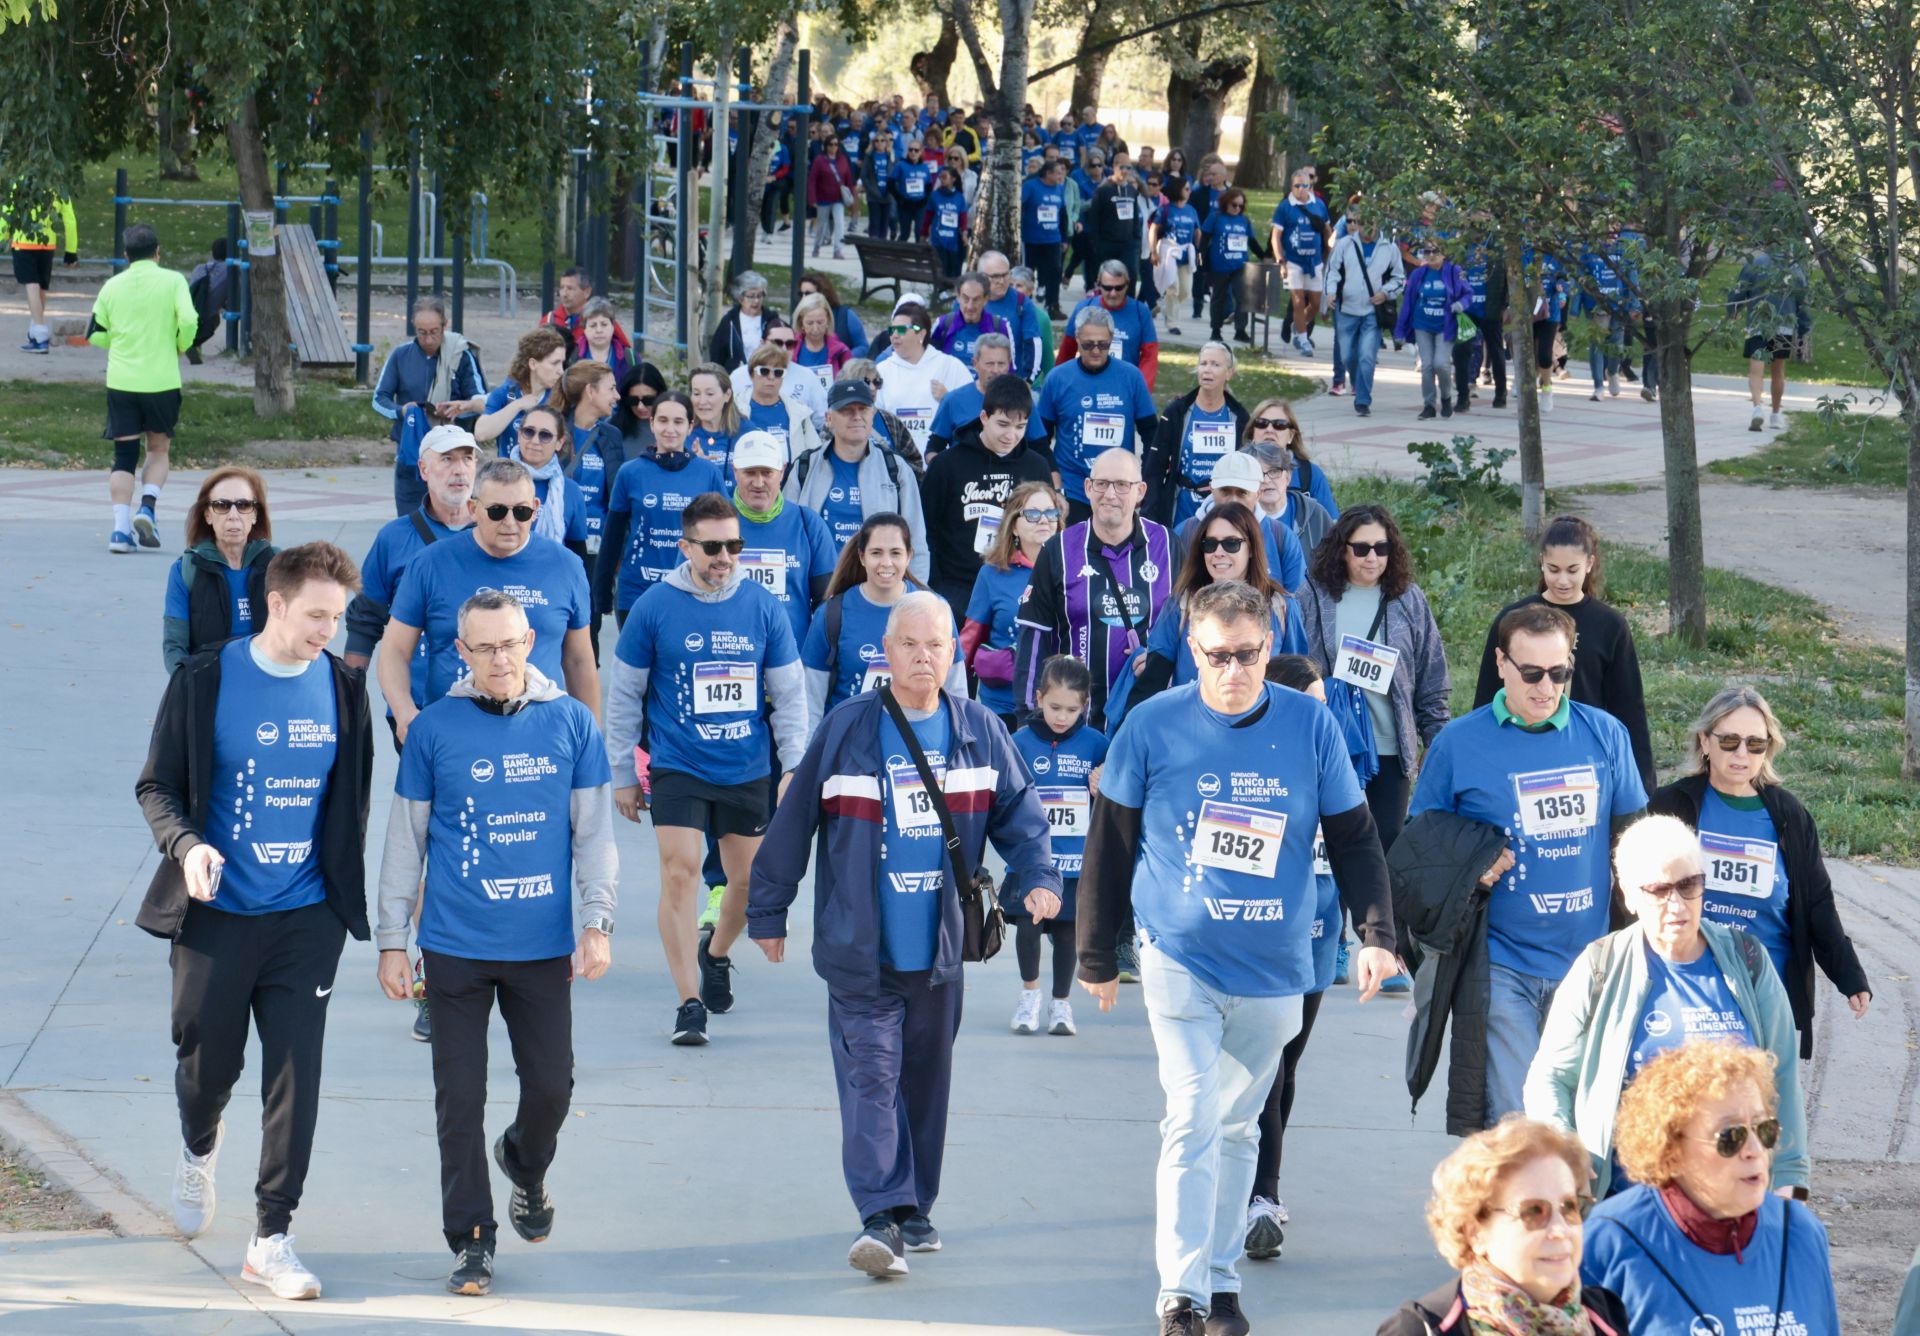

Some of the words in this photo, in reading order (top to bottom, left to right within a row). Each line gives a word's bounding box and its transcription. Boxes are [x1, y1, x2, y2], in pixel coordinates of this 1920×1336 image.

[1094, 427, 1115, 440] 1117
[1203, 435, 1226, 447] 1118
[835, 522, 861, 530] Camin
[649, 538, 679, 549] Popular
[532, 590, 542, 598] DE
[518, 597, 549, 606] MENTOS
[711, 635, 738, 643] BANCO
[712, 642, 754, 651] ALIMENTOS
[1347, 656, 1382, 681] 1409
[705, 682, 742, 702] 1473
[288, 724, 318, 734] BANCO
[320, 724, 331, 733] DE
[725, 725, 752, 740] ULSA
[288, 733, 337, 743] ALIMENTOS
[503, 757, 535, 768] BANCO
[537, 756, 549, 766] DE
[1057, 758, 1081, 766] BANCO
[1083, 760, 1092, 768] DE
[505, 764, 558, 777] ALIMENTOS
[1231, 778, 1264, 787] BANCO
[1267, 778, 1280, 787] DE
[1232, 787, 1288, 797] ALIMENTOS
[265, 795, 313, 810] Popular
[1534, 793, 1586, 820] 1353
[487, 811, 546, 826] Caminata
[1044, 808, 1075, 826] 475
[489, 829, 538, 846] Popular
[1211, 830, 1265, 862] 1352
[1537, 844, 1582, 860] Popular
[1711, 859, 1758, 884] 1351
[518, 873, 551, 885] COMERCIAL
[922, 876, 943, 892] ULS
[518, 880, 554, 899] ULSA
[1244, 898, 1283, 906] COMERCIAL
[1565, 893, 1594, 912] ULSA
[1243, 906, 1284, 921] ULSA
[1703, 900, 1757, 919] Caminata
[1682, 1012, 1720, 1022] BANCO
[1721, 1011, 1736, 1020] DE
[1684, 1020, 1745, 1032] ALIMENTOS
